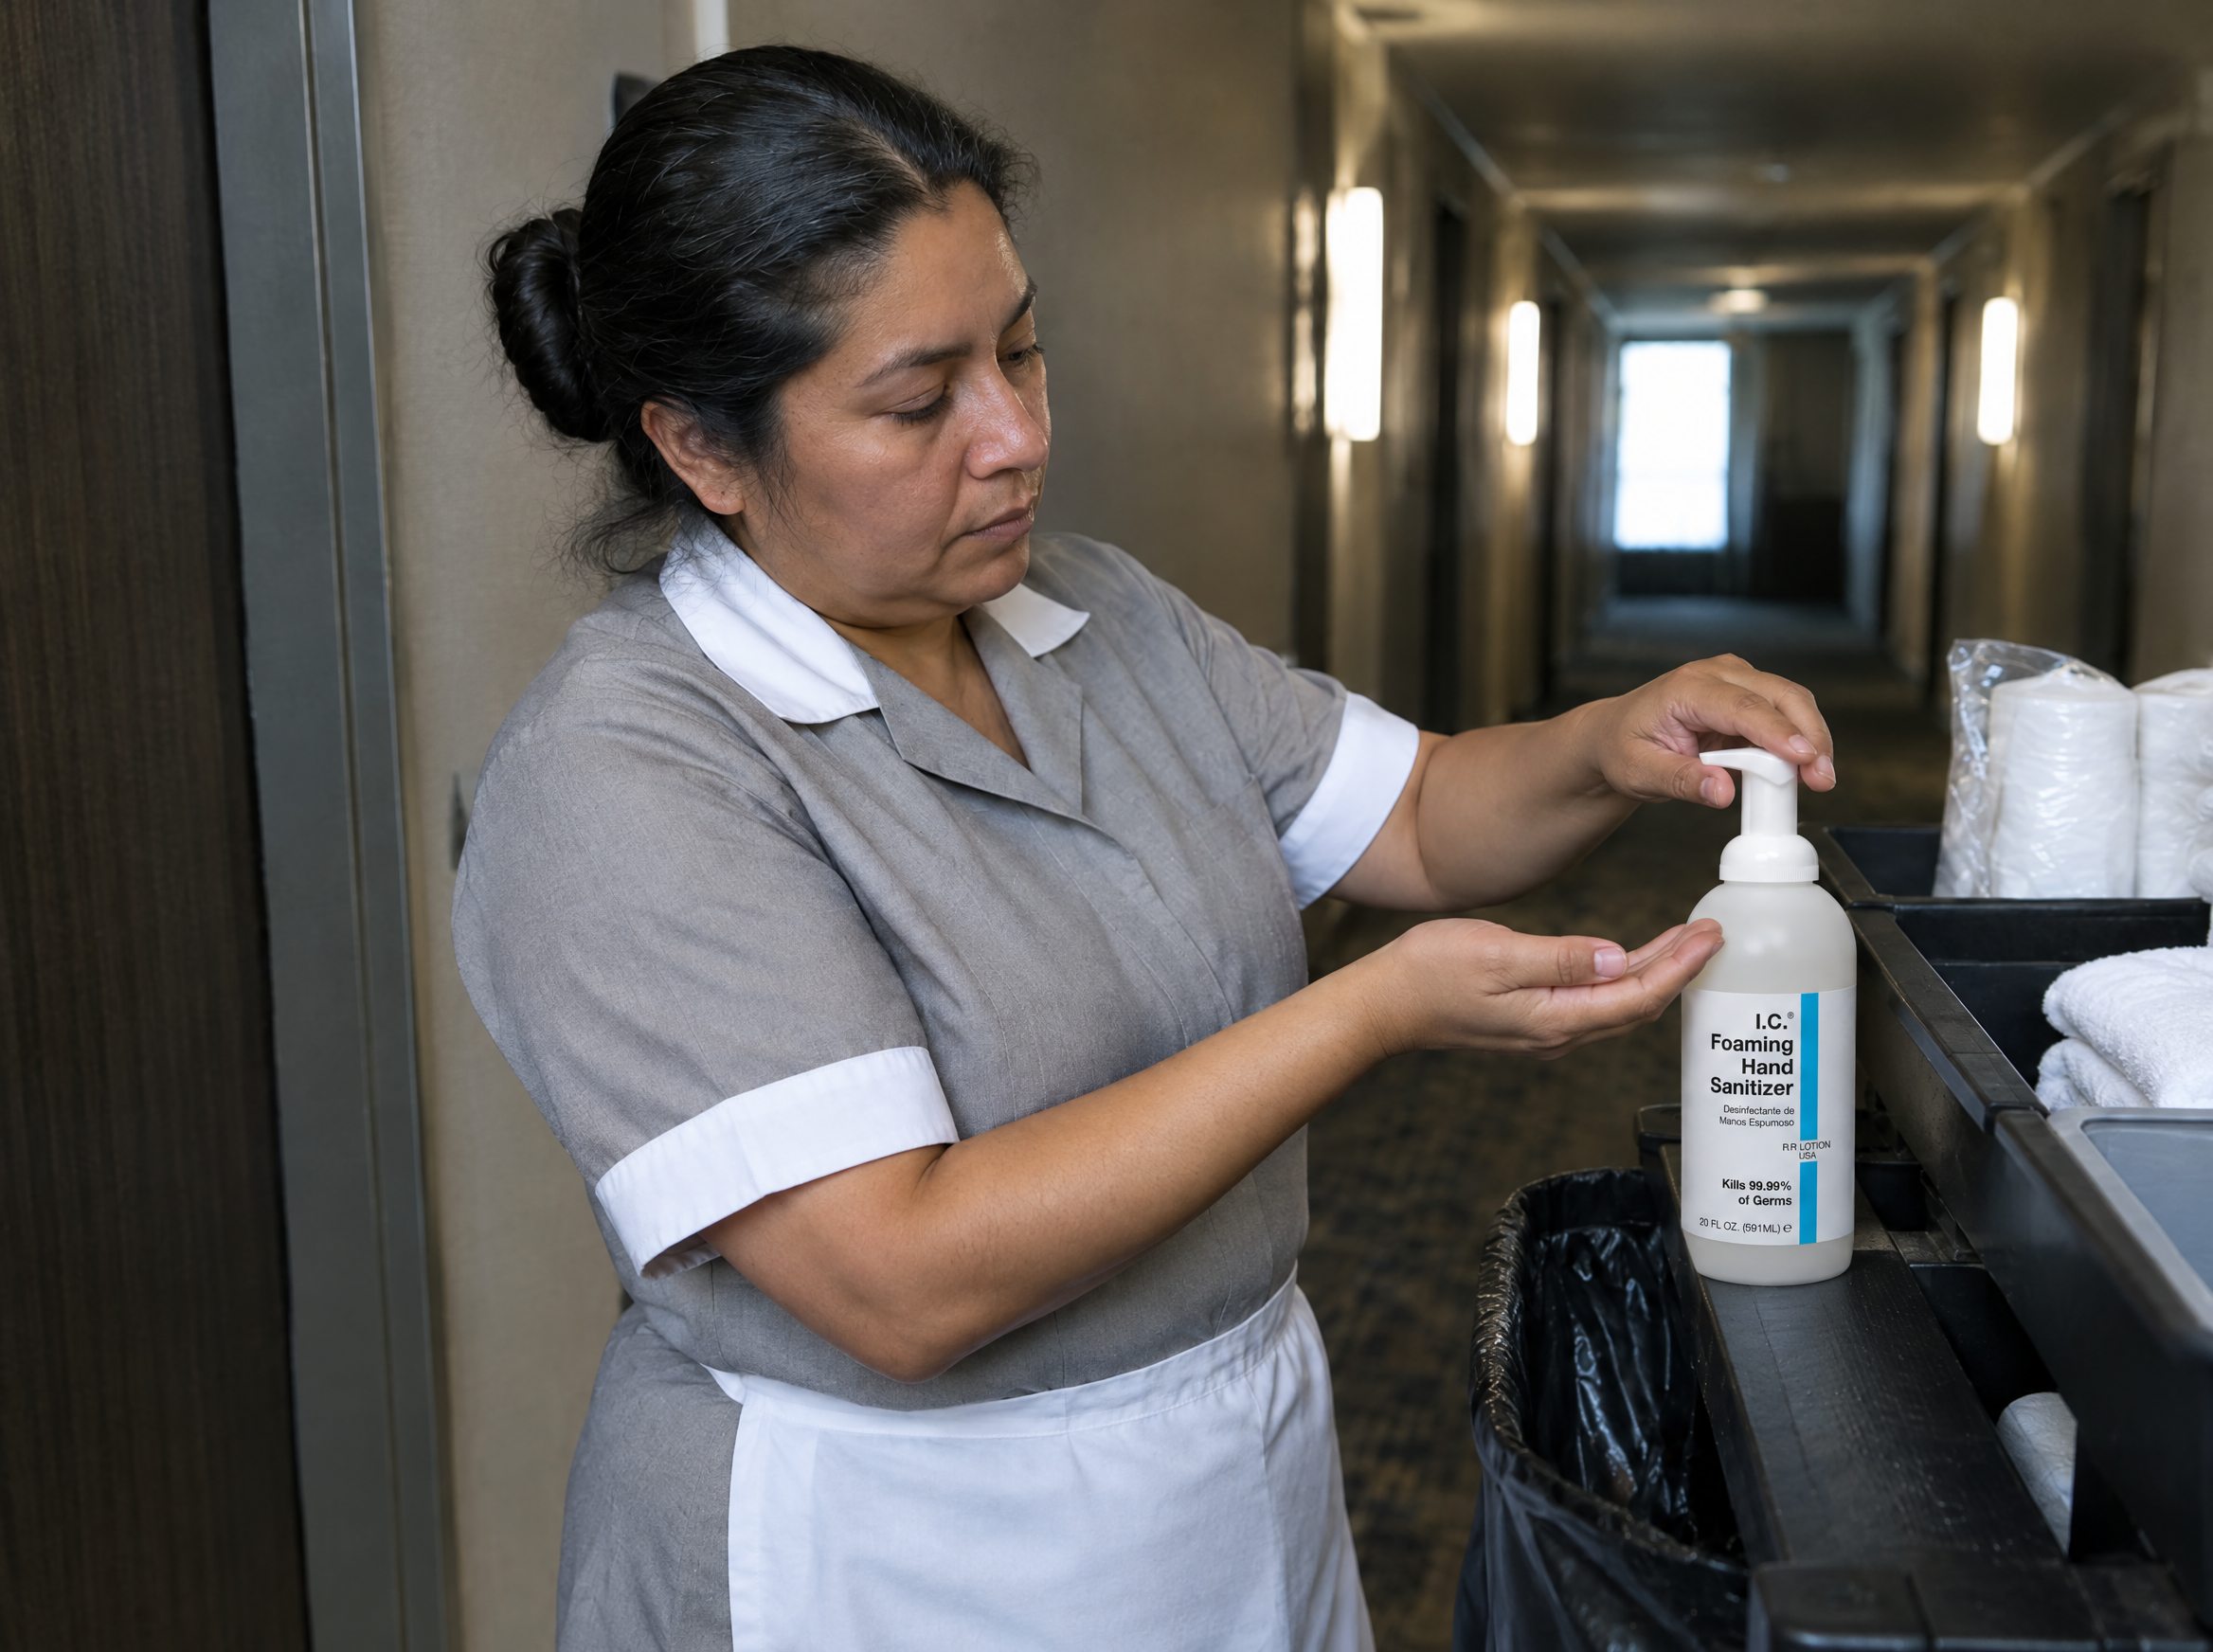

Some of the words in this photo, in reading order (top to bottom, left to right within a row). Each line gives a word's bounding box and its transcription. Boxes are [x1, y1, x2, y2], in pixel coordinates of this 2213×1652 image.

[1711, 1033, 1793, 1056] Foaming
[1741, 1058, 1793, 1075] Hand
[1710, 1077, 1794, 1096] Sanitizer
[1723, 1104, 1781, 1115] Desinfectante
[1783, 1106, 1795, 1115] de
[1718, 1117, 1747, 1126] Manos
[1749, 1118, 1794, 1128] Espumoso
[1799, 1140, 1831, 1151] LOTION
[1722, 1178, 1746, 1190] Kills
[1749, 1181, 1792, 1191] 99.99%
[1738, 1195, 1750, 1205] of
[1753, 1195, 1792, 1206] Germs
[1700, 1217, 1709, 1227] 20
[1711, 1219, 1721, 1230] FL
[1723, 1221, 1740, 1231] OZ.
[1742, 1223, 1781, 1234] (591ML)
